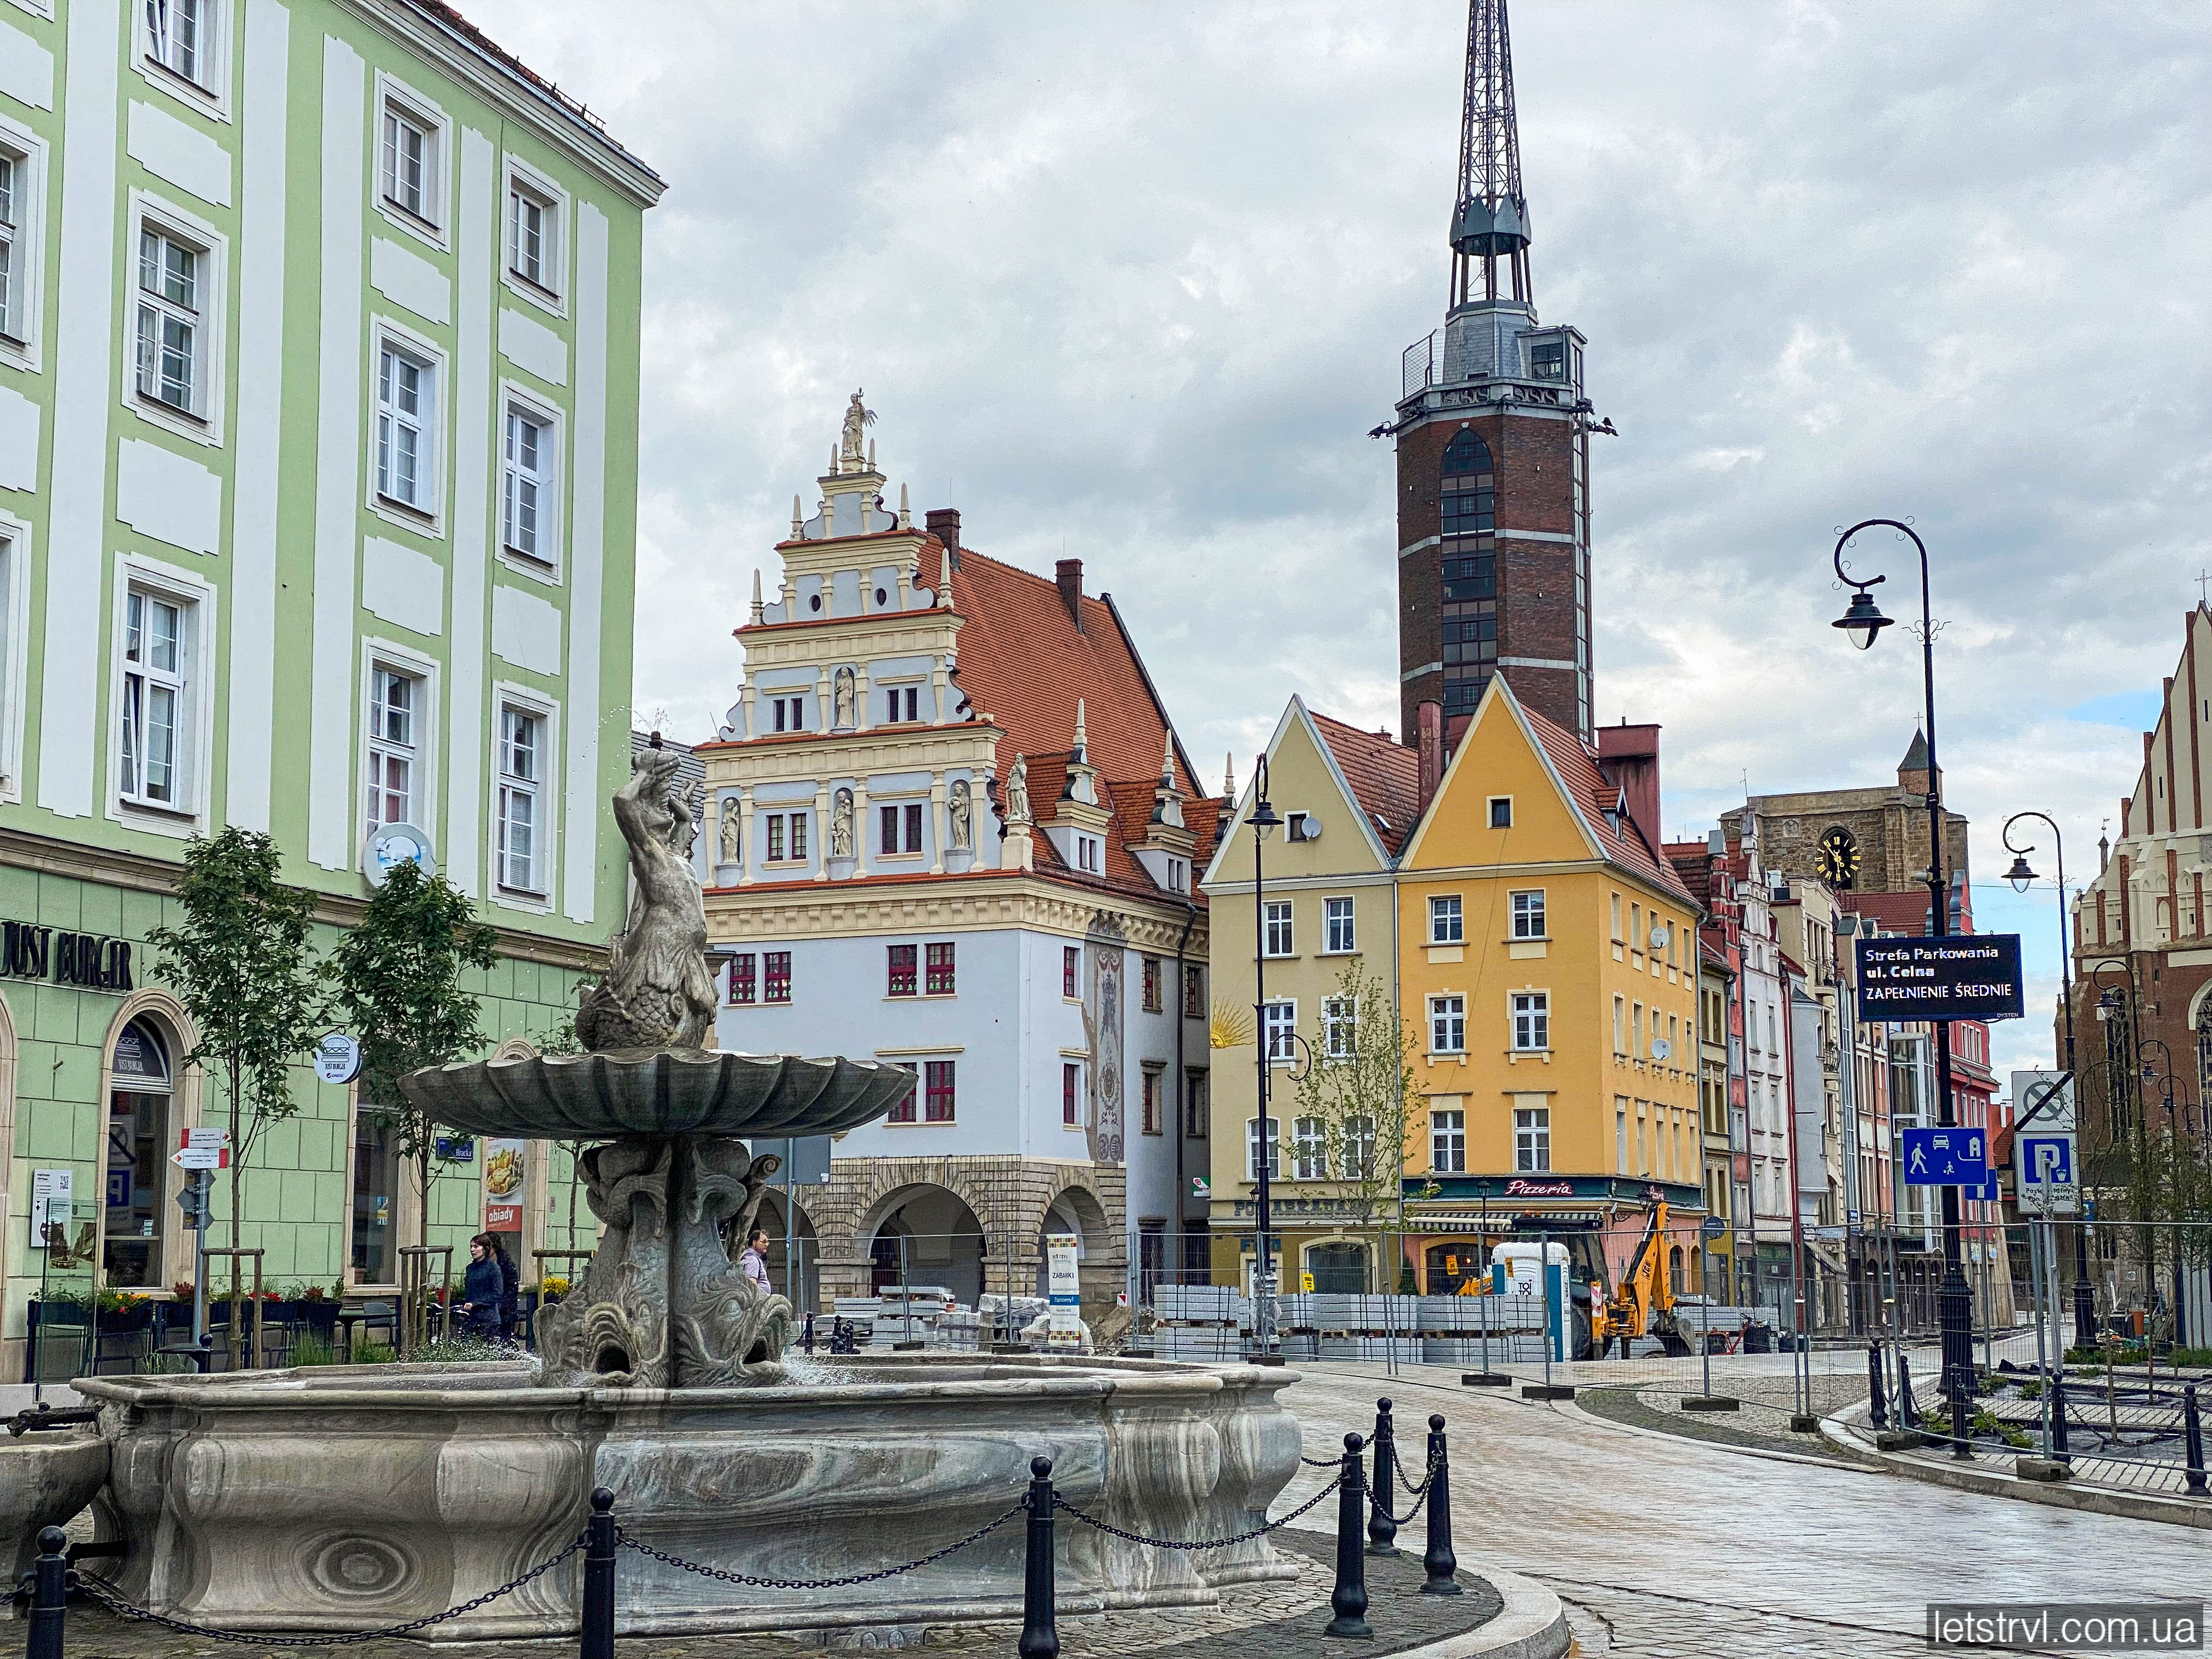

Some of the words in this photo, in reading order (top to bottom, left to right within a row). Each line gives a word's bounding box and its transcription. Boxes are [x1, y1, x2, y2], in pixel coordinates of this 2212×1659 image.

[0, 921, 53, 978] JUST
[56, 932, 133, 991] BURGER
[1866, 949, 1910, 961] Strefa
[1914, 946, 1999, 960] Parkowania
[1866, 967, 1887, 979] ul.
[1891, 966, 1934, 978] Celna
[1866, 986, 1949, 1000] ZAPEŁNIENIE
[1955, 982, 2012, 997] ŚREDNIE
[455, 1148, 472, 1157] Bracka
[1504, 1180, 1572, 1194] Pizzeria
[489, 1206, 514, 1222] obiady
[1271, 1199, 1373, 1215] ARKADA
